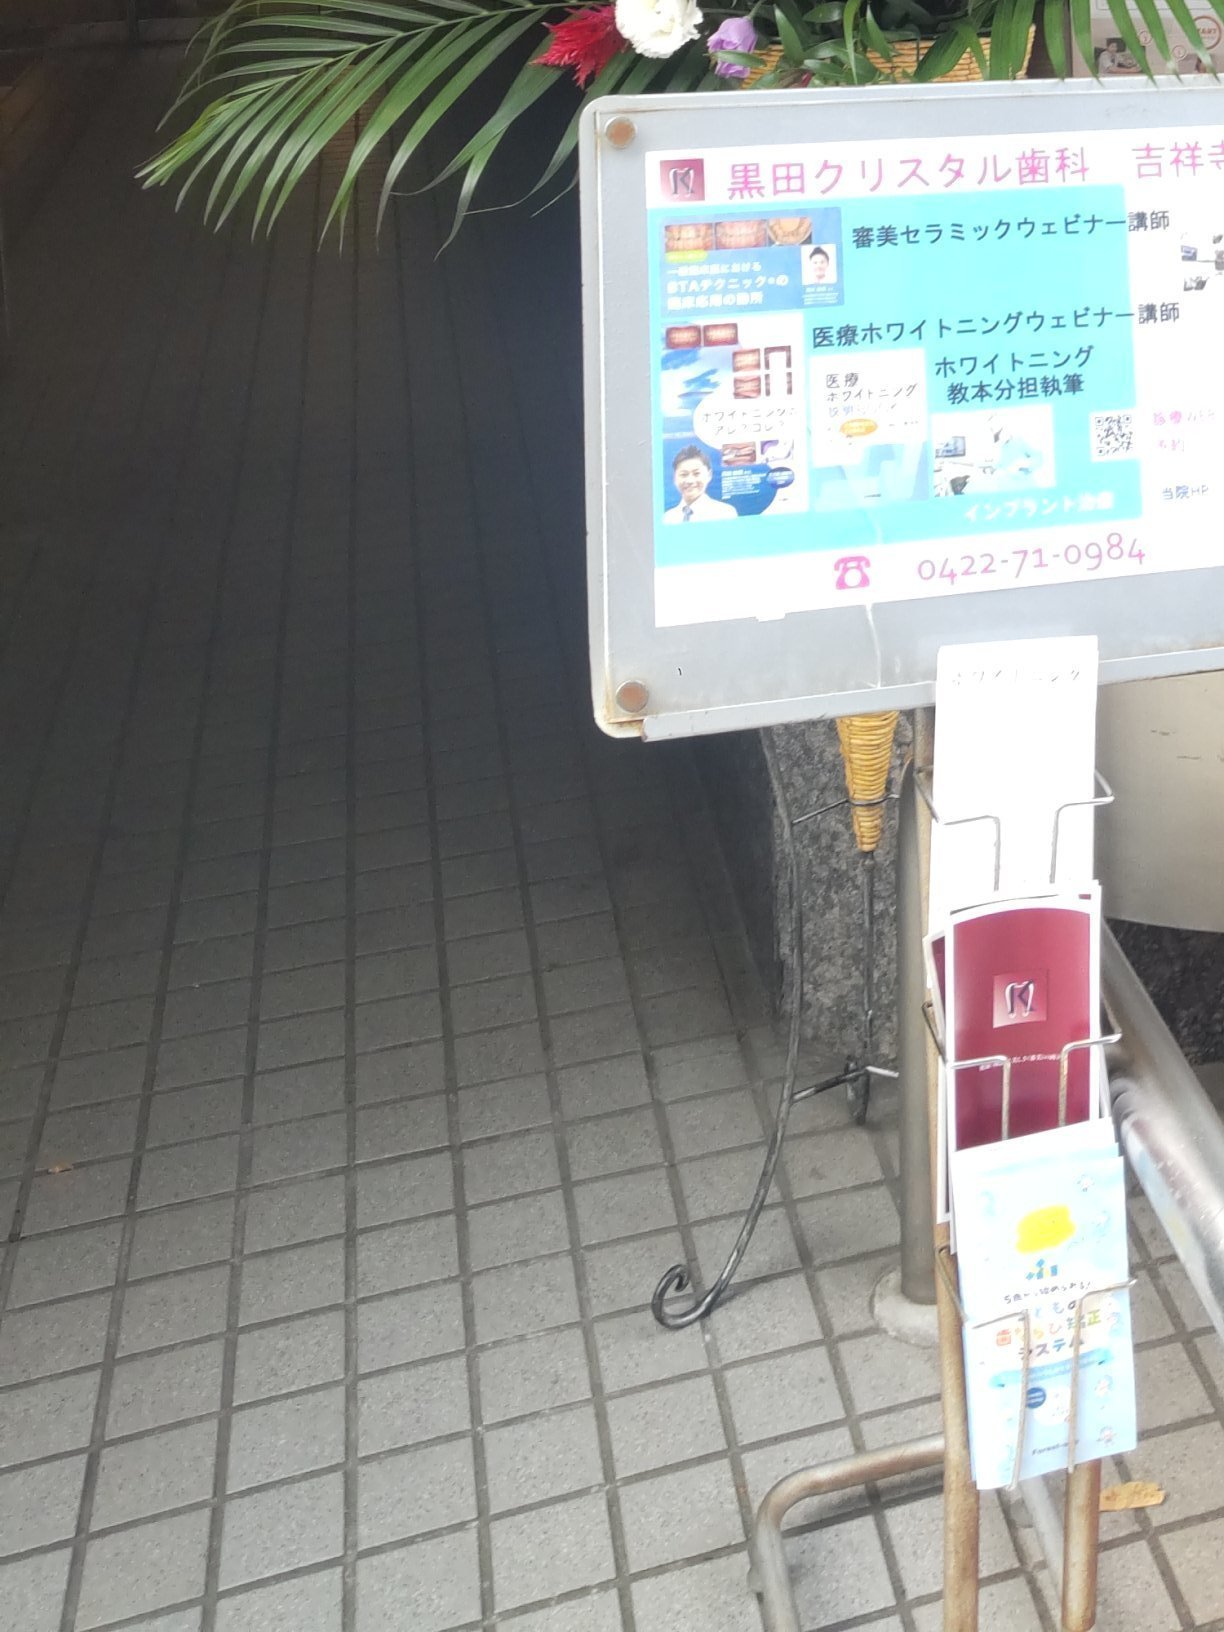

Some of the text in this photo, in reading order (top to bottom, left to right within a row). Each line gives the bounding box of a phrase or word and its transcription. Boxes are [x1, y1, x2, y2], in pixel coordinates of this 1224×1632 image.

[727, 146, 1090, 200] 黒田クリスタル歯科
[851, 209, 1171, 250] 審美セラミックウェビナー講師
[812, 300, 1181, 349] 医療ホワイトニングウェビナー講師
[935, 344, 1094, 378] ホワイトニング
[946, 371, 1086, 406] 教本分担執筆
[917, 532, 1147, 585] 0422-71-0984
